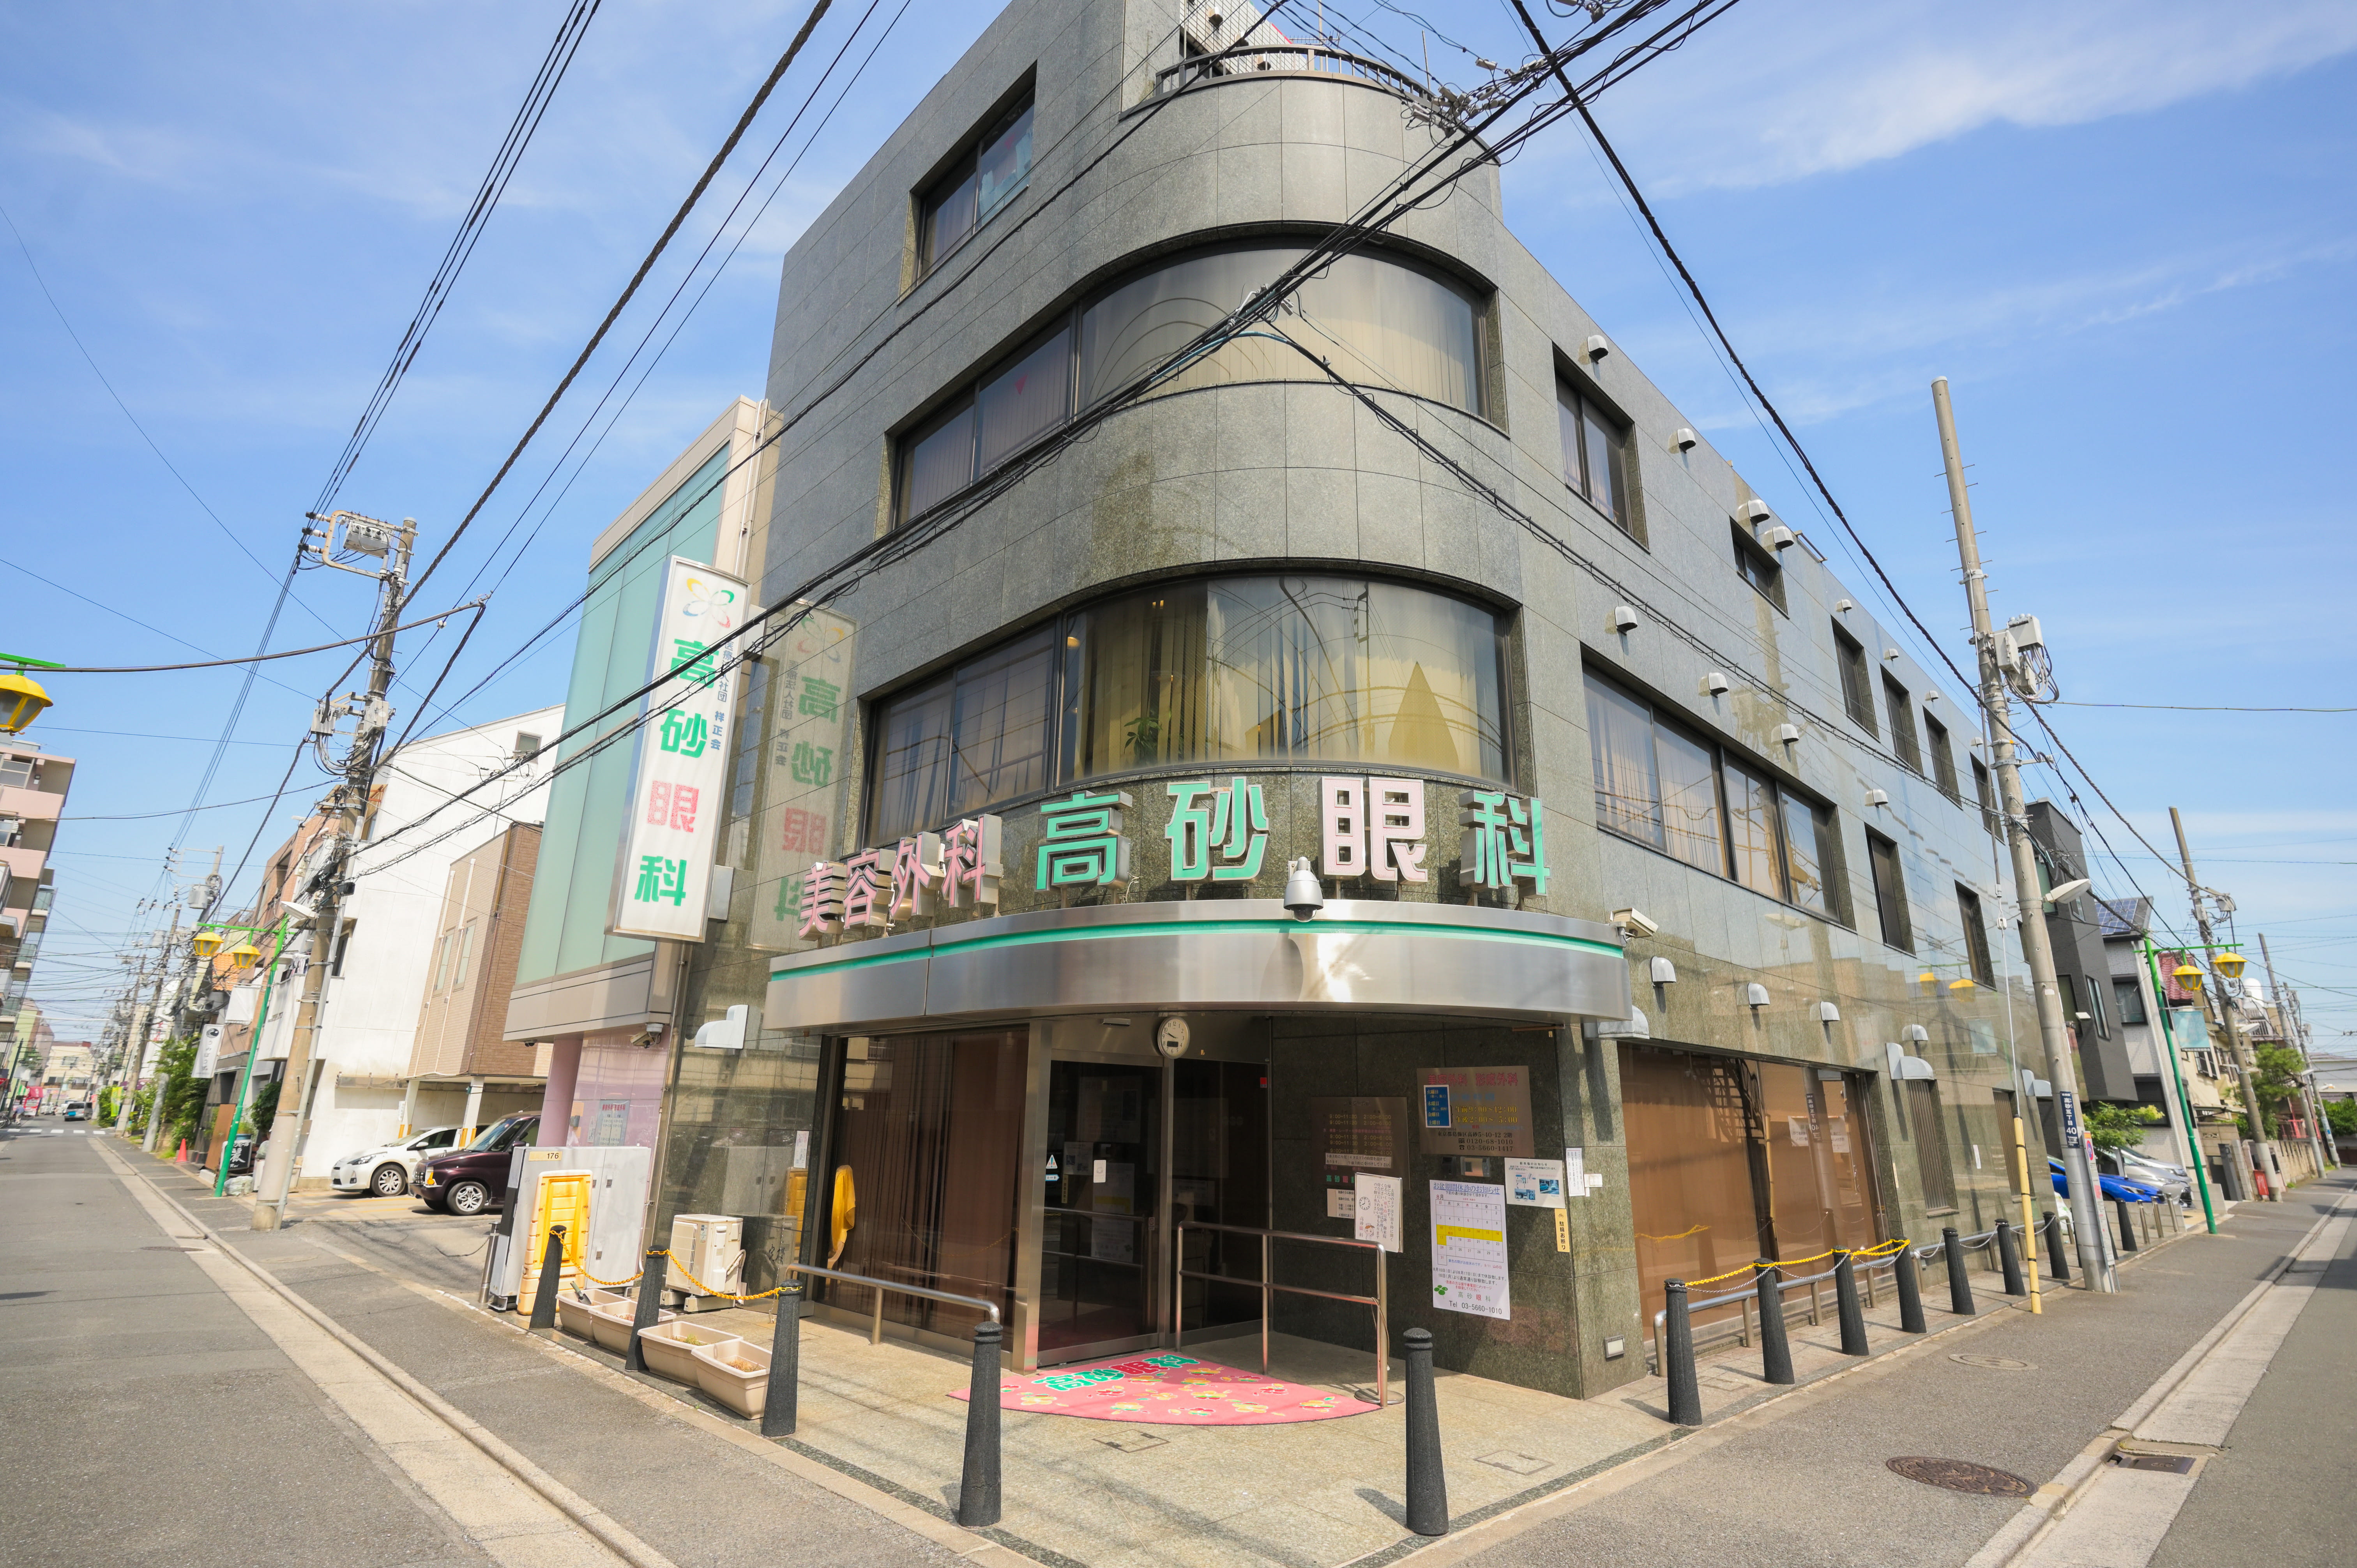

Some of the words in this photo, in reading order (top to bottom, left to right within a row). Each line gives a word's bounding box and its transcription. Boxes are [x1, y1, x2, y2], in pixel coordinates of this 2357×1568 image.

[710, 711, 724, 750] 祥正会
[634, 638, 719, 907] 高砂眼科
[1035, 776, 1552, 898] 高砂眼科
[799, 814, 1002, 941] 美容外科
[1428, 1073, 1468, 1086] 美容外科
[1475, 1072, 1518, 1086] 形成外科
[1433, 1182, 1500, 1194] お盆期間休診のお知らせ
[1458, 1292, 1491, 1302] 高砂眼科
[1461, 1302, 1502, 1314] 03-5660-1010
[1031, 1354, 1200, 1391] 高砂眼科
